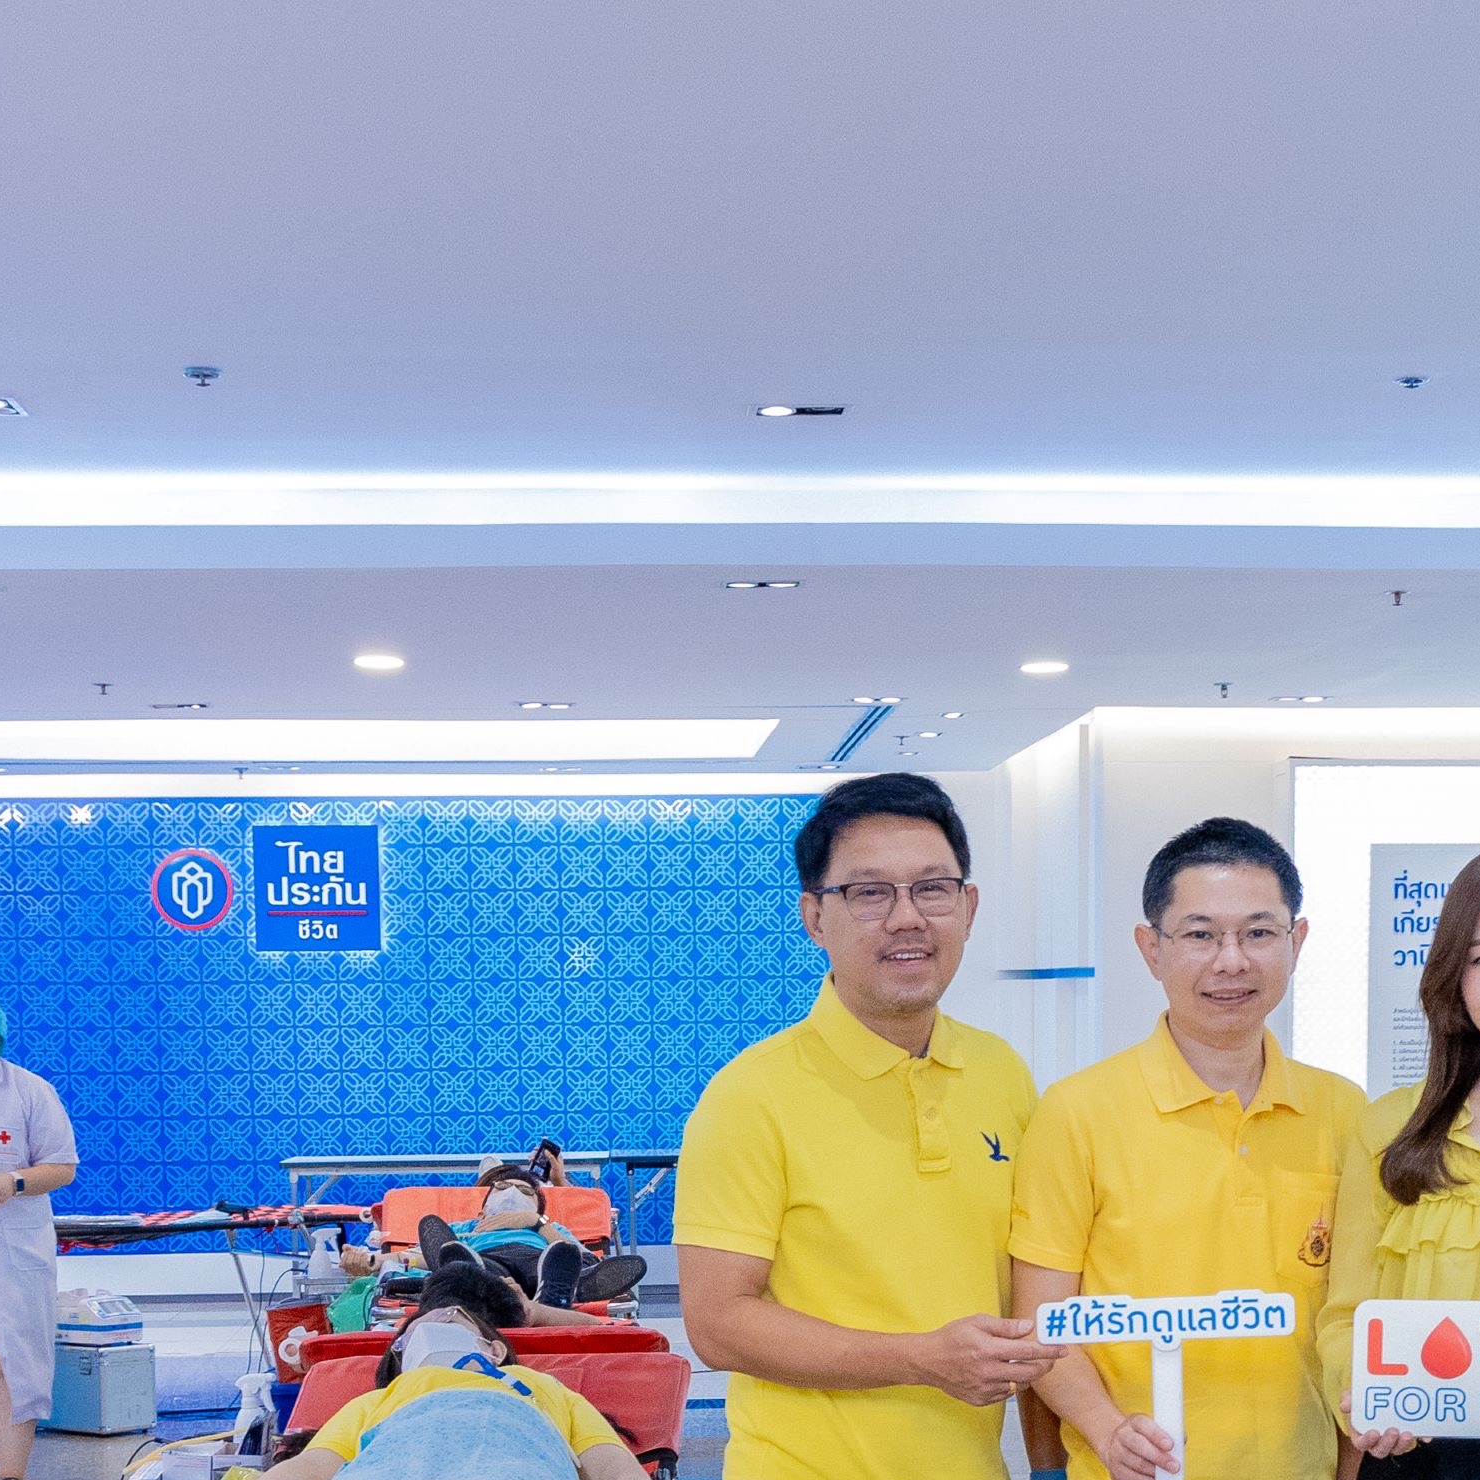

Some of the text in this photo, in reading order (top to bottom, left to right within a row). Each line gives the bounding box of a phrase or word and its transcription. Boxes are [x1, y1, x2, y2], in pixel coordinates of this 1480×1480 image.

[274, 841, 344, 874] ไทย
[267, 876, 368, 906] ประกัน
[298, 919, 338, 939] ชีวิต
[1046, 1296, 1287, 1343] #ให้รักดูแลชีวิต
[1365, 1386, 1467, 1422] FOR
